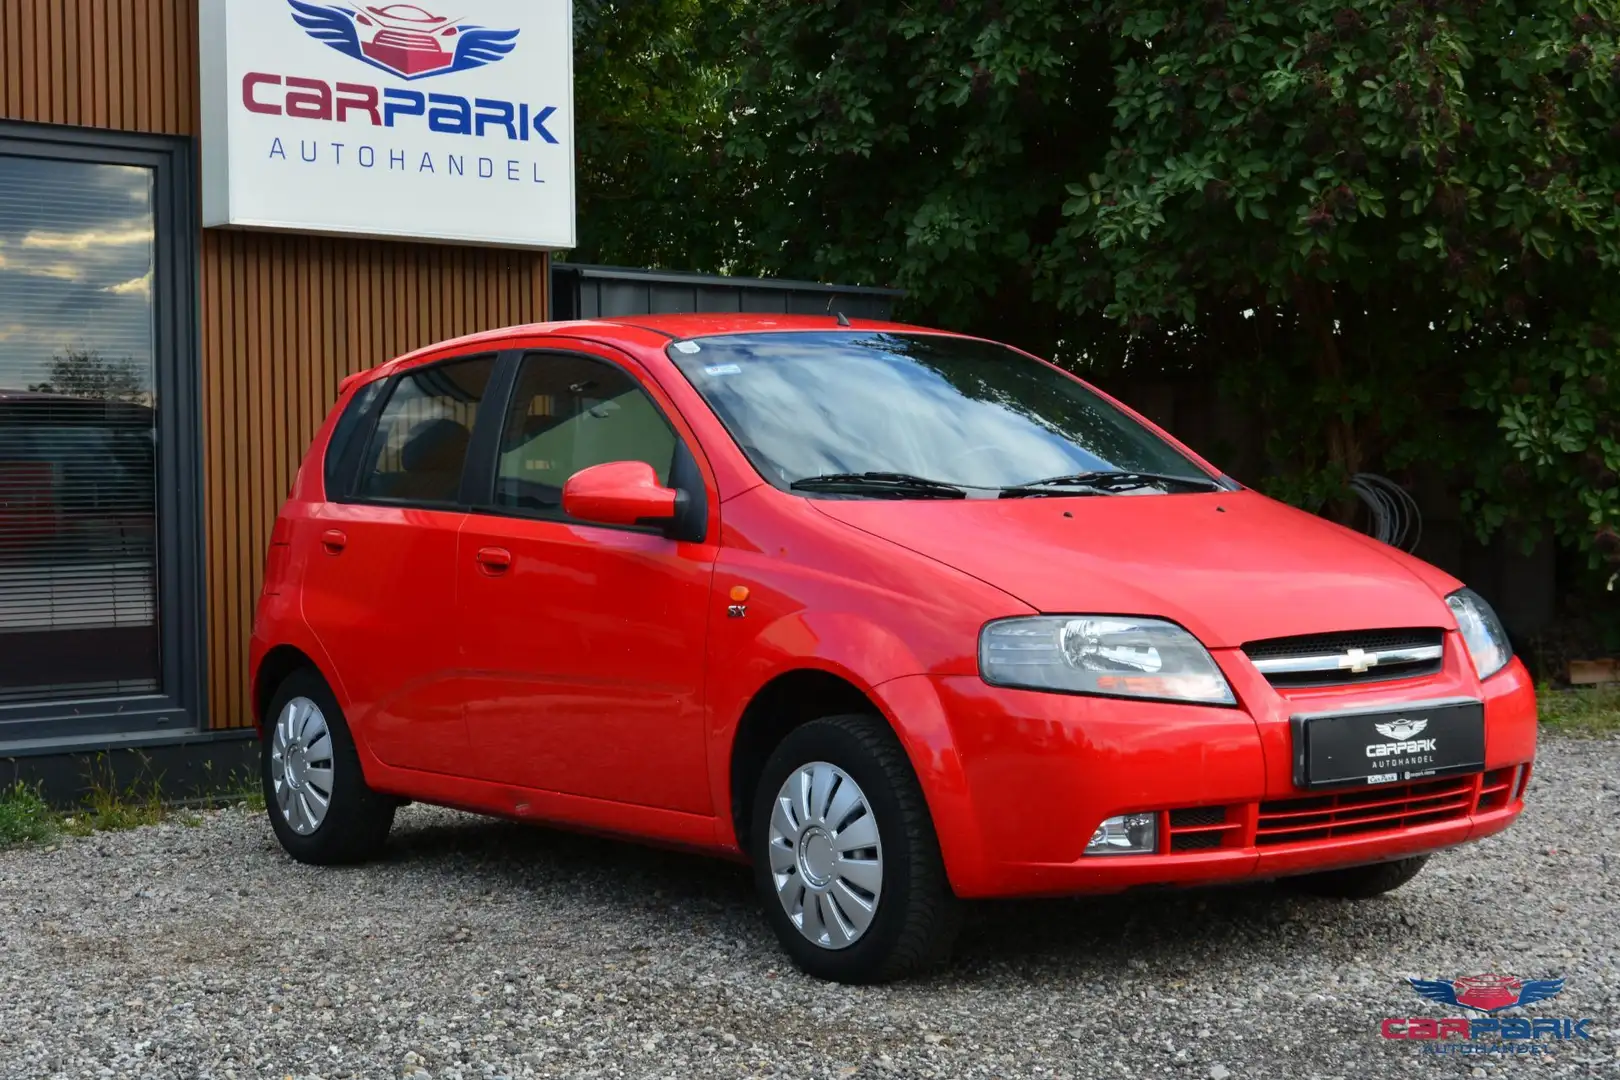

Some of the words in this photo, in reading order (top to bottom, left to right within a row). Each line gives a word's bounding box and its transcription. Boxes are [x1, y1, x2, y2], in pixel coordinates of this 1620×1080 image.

[269, 137, 546, 184] AUTOHANDEL
[728, 605, 746, 617] SX
[1372, 755, 1434, 769] AUTOHANDEL
